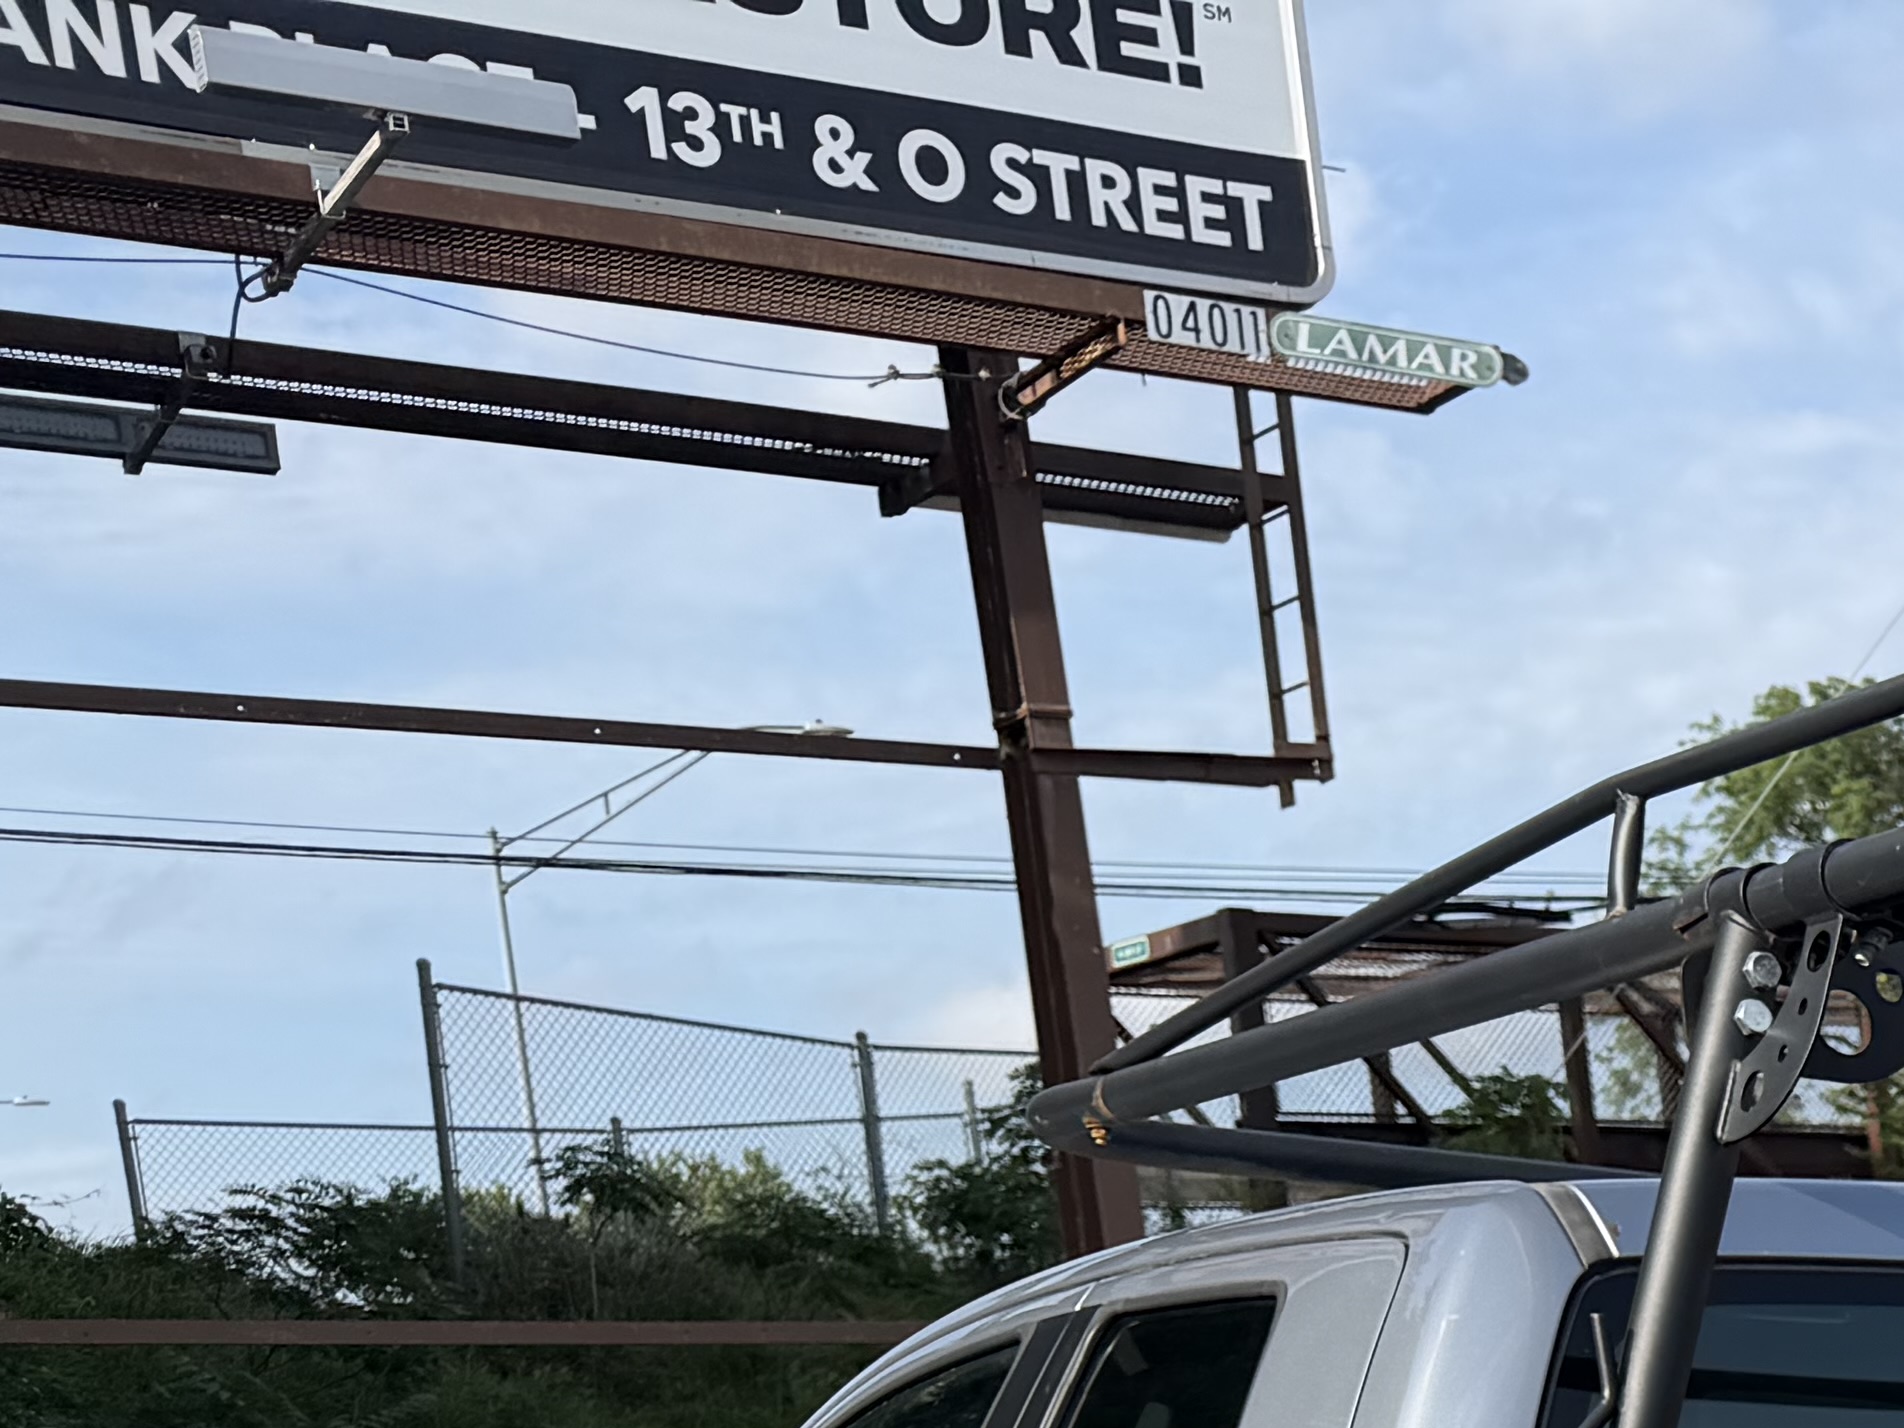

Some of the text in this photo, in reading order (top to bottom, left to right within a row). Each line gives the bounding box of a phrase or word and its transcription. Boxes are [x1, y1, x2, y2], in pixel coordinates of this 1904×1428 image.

[624, 85, 1273, 251] 13TH & O STREET
[1152, 294, 1478, 379] 04011 LAMAR
